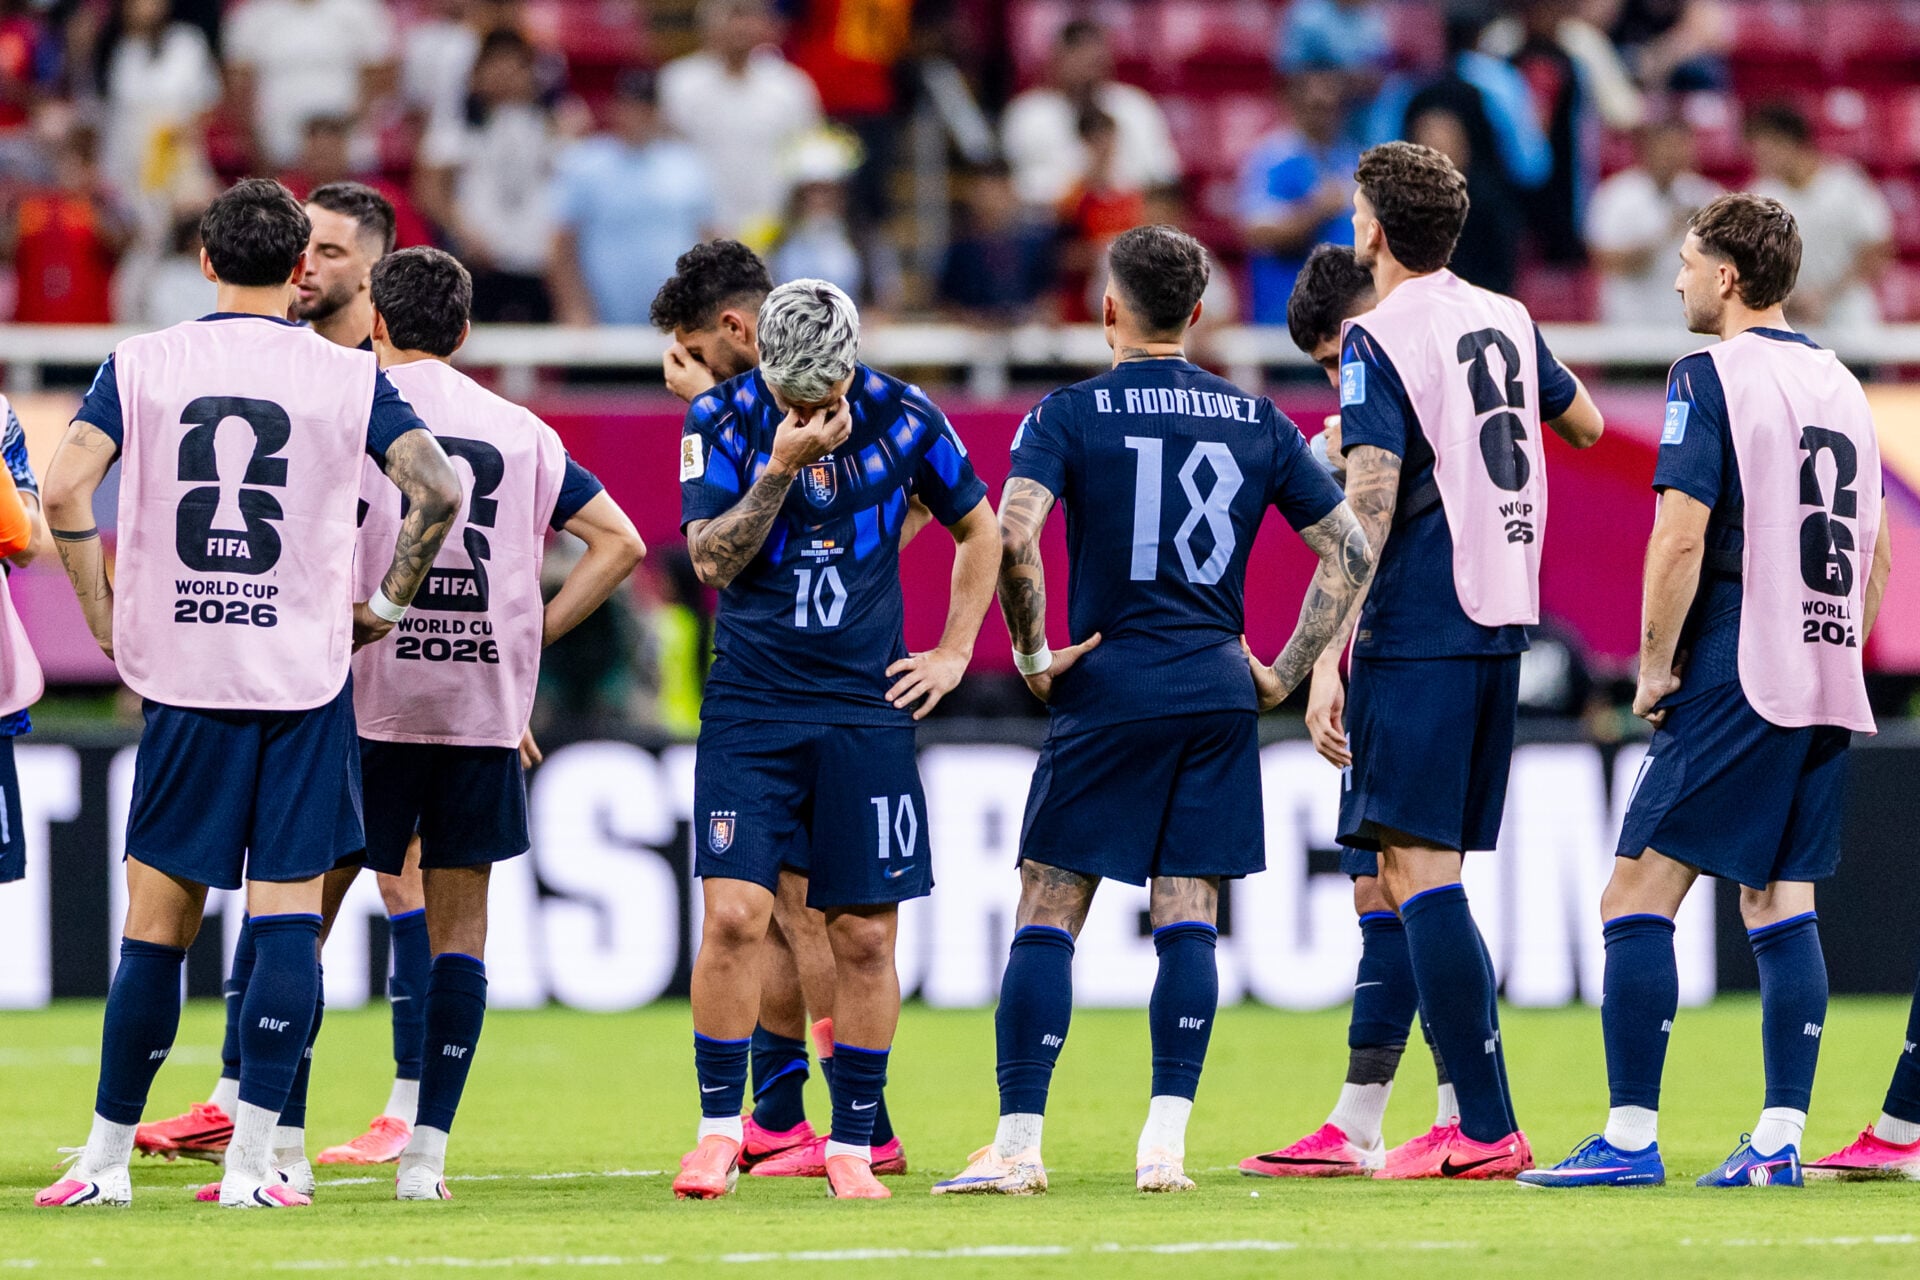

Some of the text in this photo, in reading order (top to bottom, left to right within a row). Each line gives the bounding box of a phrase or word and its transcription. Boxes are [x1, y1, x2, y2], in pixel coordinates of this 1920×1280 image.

[1124, 387, 1261, 423] RODRÍGUEZ
[1124, 435, 1245, 585] 18
[206, 538, 251, 559] FIFA
[175, 580, 279, 599] WORLD CUP
[429, 576, 479, 597] FIFA
[793, 565, 848, 627] 10
[174, 599, 278, 628] 2026
[1802, 600, 1850, 620] WORL
[399, 617, 493, 636] WORLD CU
[395, 636, 500, 664] 2026
[870, 794, 918, 859] 10
[442, 1044, 468, 1059] AUF
